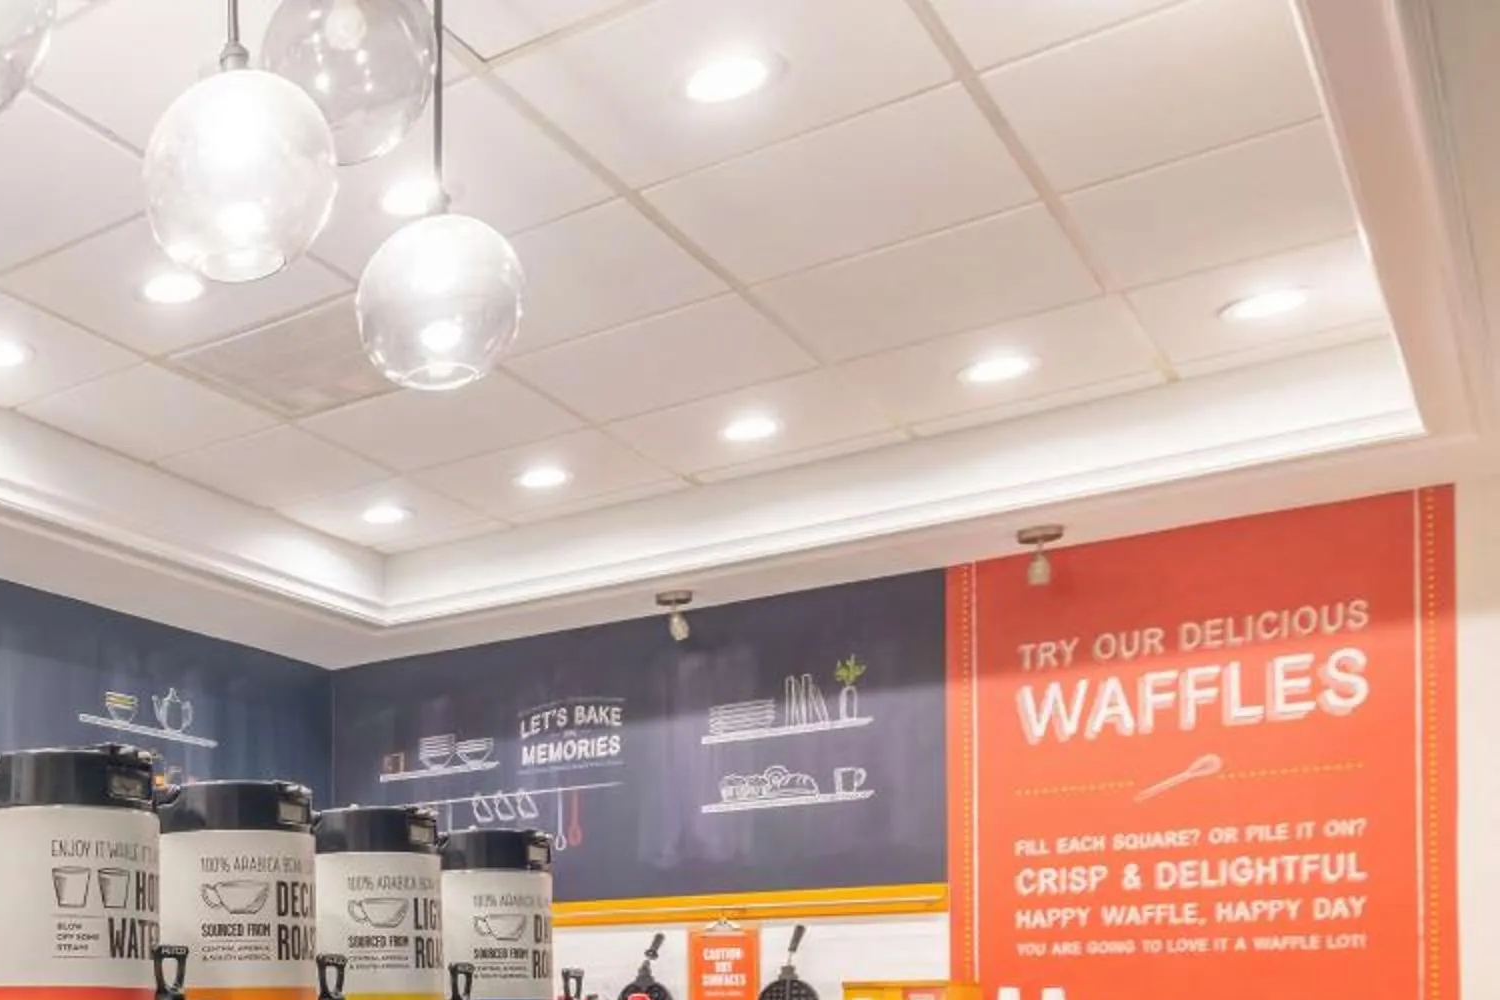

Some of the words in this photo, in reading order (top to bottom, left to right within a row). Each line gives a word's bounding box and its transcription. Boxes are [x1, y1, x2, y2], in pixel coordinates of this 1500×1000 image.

[1017, 637, 1079, 672] TRY
[1093, 627, 1165, 660] OUR
[1179, 598, 1369, 652] DELICIOUS
[1016, 647, 1369, 745] WAFFLES
[520, 707, 567, 739] LET'S
[574, 705, 622, 727] BAKE
[522, 735, 621, 766] MEMORIES
[51, 839, 90, 857] ENJOY
[1014, 839, 1050, 856] FILL
[1056, 836, 1105, 854] EACH
[1113, 828, 1201, 851] SQUARE?
[1208, 827, 1238, 844] OR
[1245, 823, 1289, 842] PILE
[1296, 821, 1315, 839] IT
[1324, 817, 1367, 837] ON?
[1015, 865, 1108, 896] CRISP
[1122, 863, 1141, 890] &
[1156, 852, 1368, 891] DELIGHTFUL
[135, 870, 159, 913] HO
[414, 897, 442, 930] LIG
[1015, 907, 1091, 929] HAPPY
[1102, 903, 1207, 926] WAFFLE,
[1215, 899, 1301, 924] HAPPY
[1313, 896, 1367, 920] DAY
[201, 923, 244, 937] SOURCED
[248, 923, 271, 937] FROM
[1017, 942, 1047, 957] YOU
[1052, 940, 1082, 955] ARE
[1142, 938, 1162, 953] TO
[1167, 937, 1209, 953] LOVE
[1213, 937, 1228, 951] IT
[1234, 937, 1247, 951] A
[1253, 934, 1321, 950] WAFFLE
[414, 935, 444, 969] ROA
